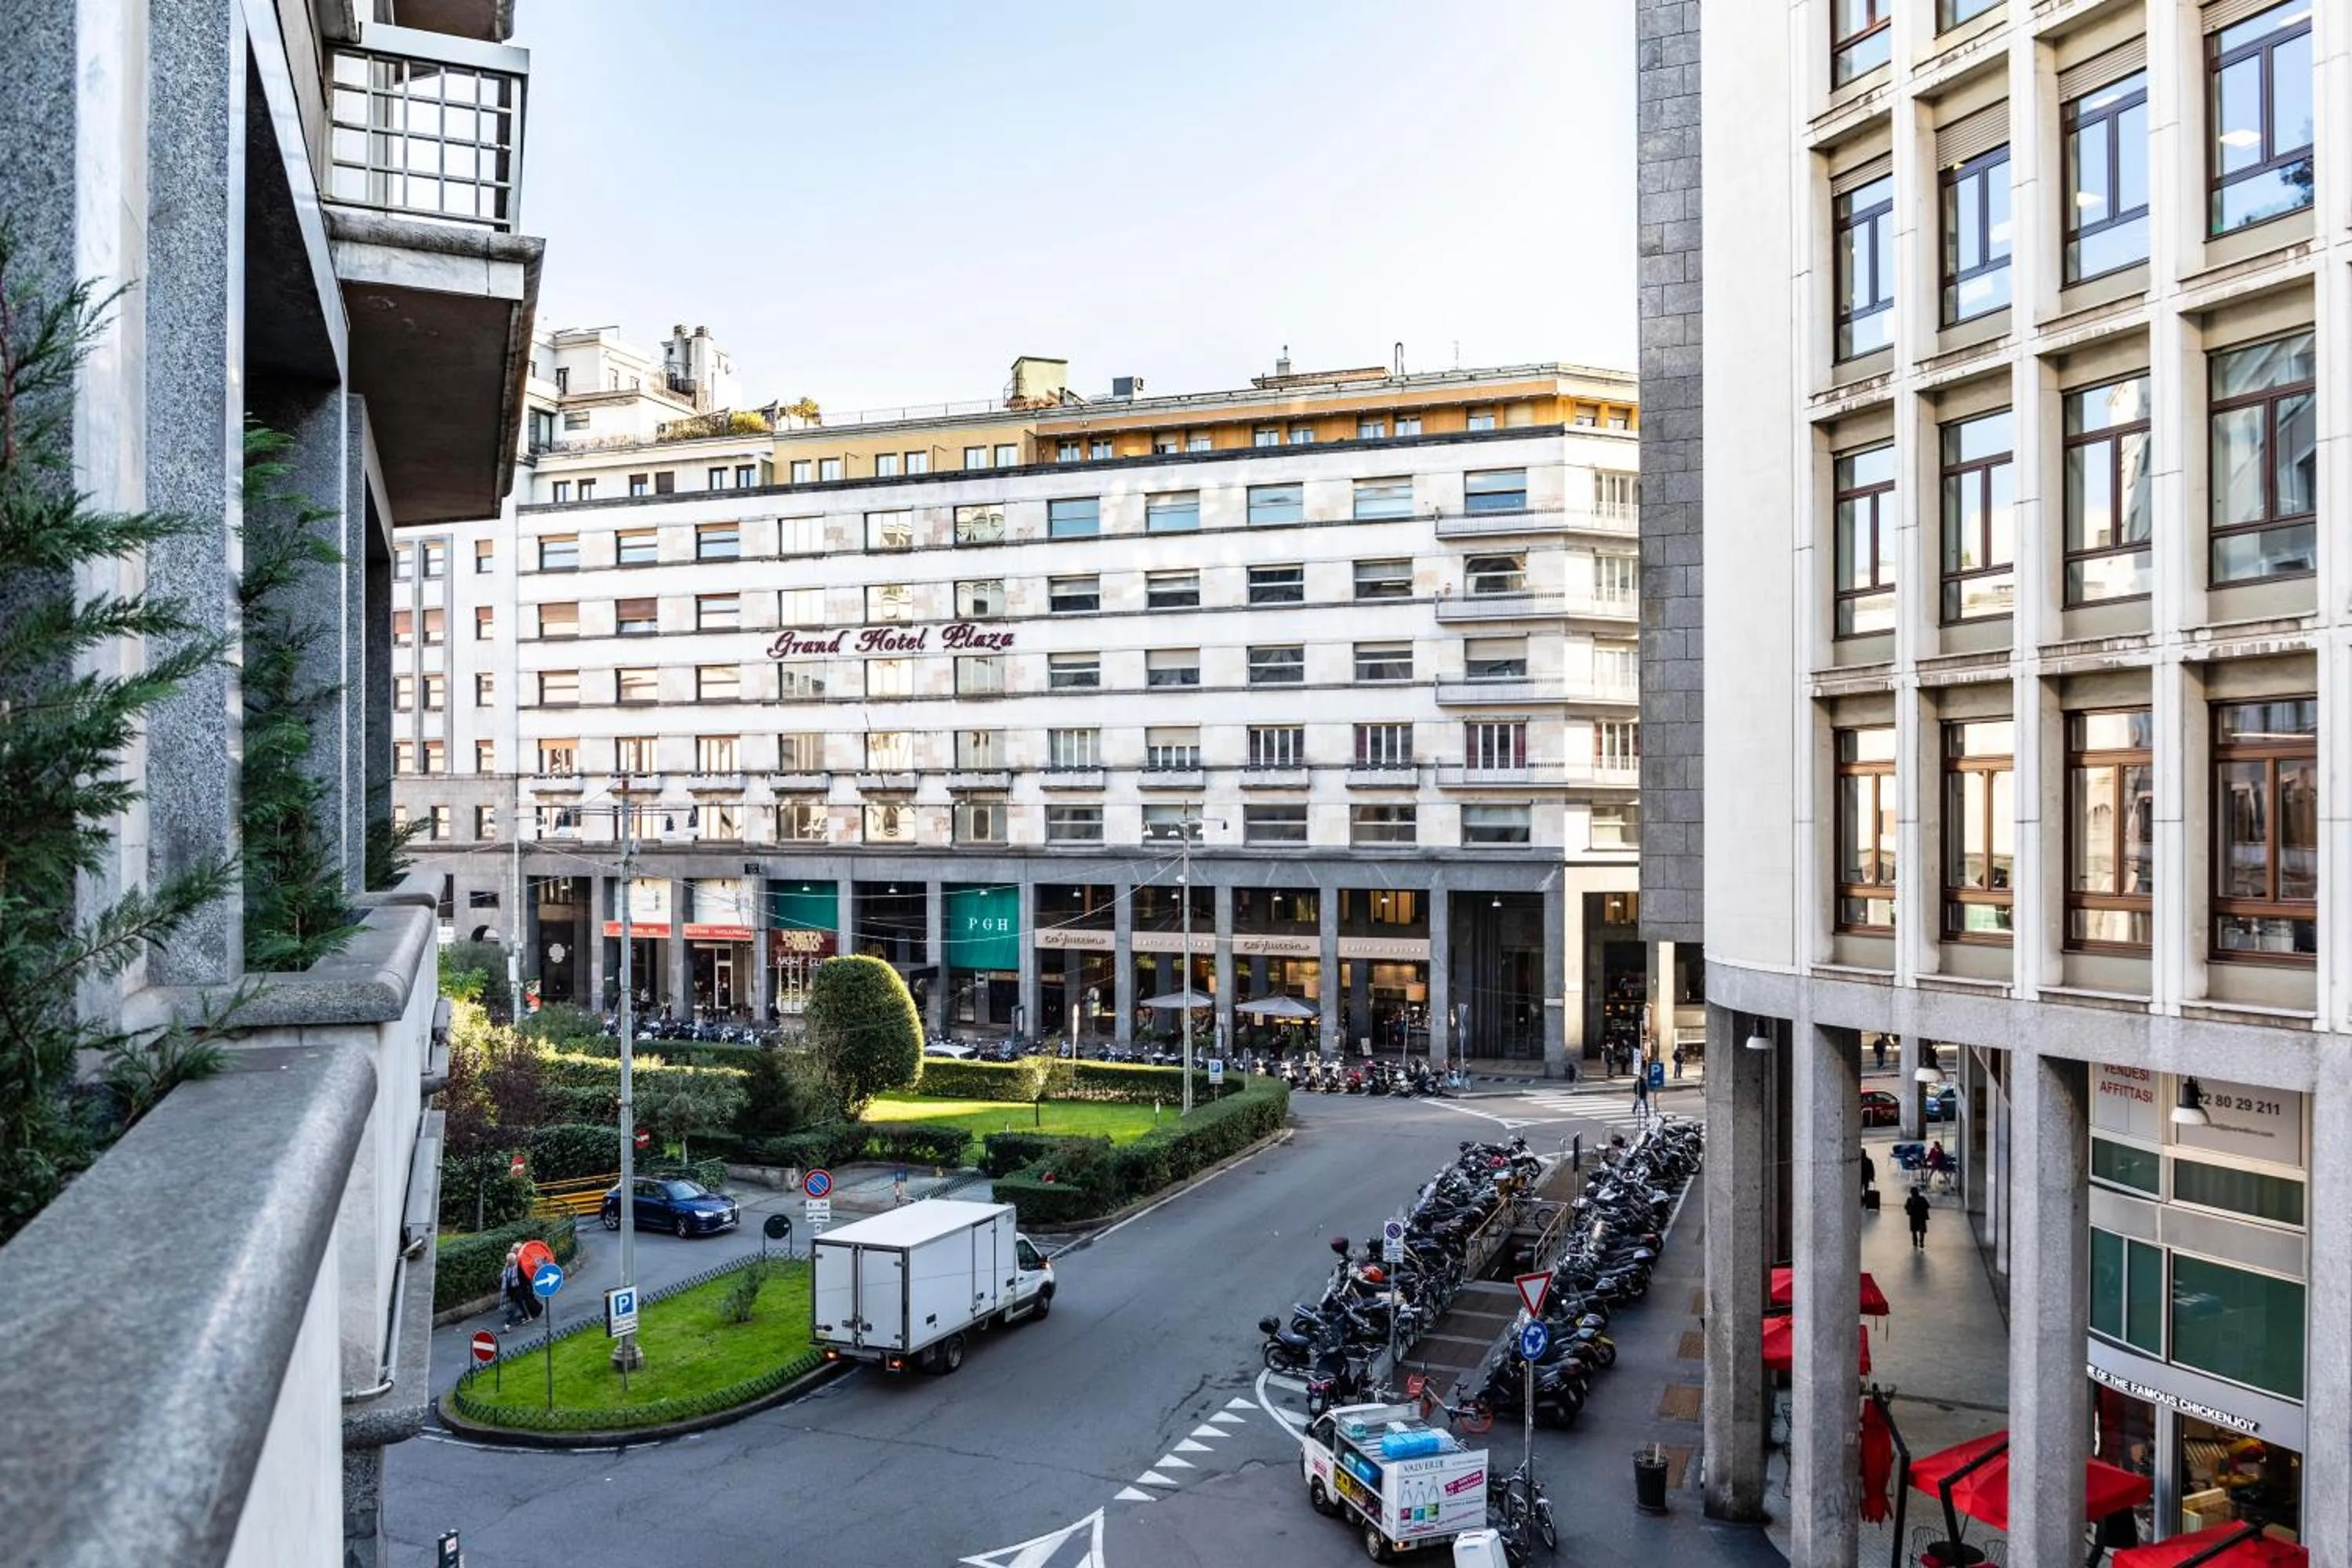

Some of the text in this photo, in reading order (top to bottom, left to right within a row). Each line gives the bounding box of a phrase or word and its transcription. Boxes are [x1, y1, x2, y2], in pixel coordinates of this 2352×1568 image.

[767, 624, 1016, 659] Grand Hotel Plaza
[967, 916, 1007, 931] PGH
[1650, 1064, 1661, 1076] P
[2103, 1063, 2151, 1081] VENDESI
[2100, 1081, 2153, 1103] AFFITTASI
[2215, 1094, 2232, 1108] 80
[2236, 1098, 2252, 1111] 29
[2256, 1101, 2281, 1116] 211
[619, 1295, 630, 1313] P
[2096, 1369, 2108, 1381] OF
[2109, 1374, 2129, 1391] THE
[2131, 1382, 2177, 1408] FAMOUS
[2180, 1399, 2256, 1432] CHICKENJOY
